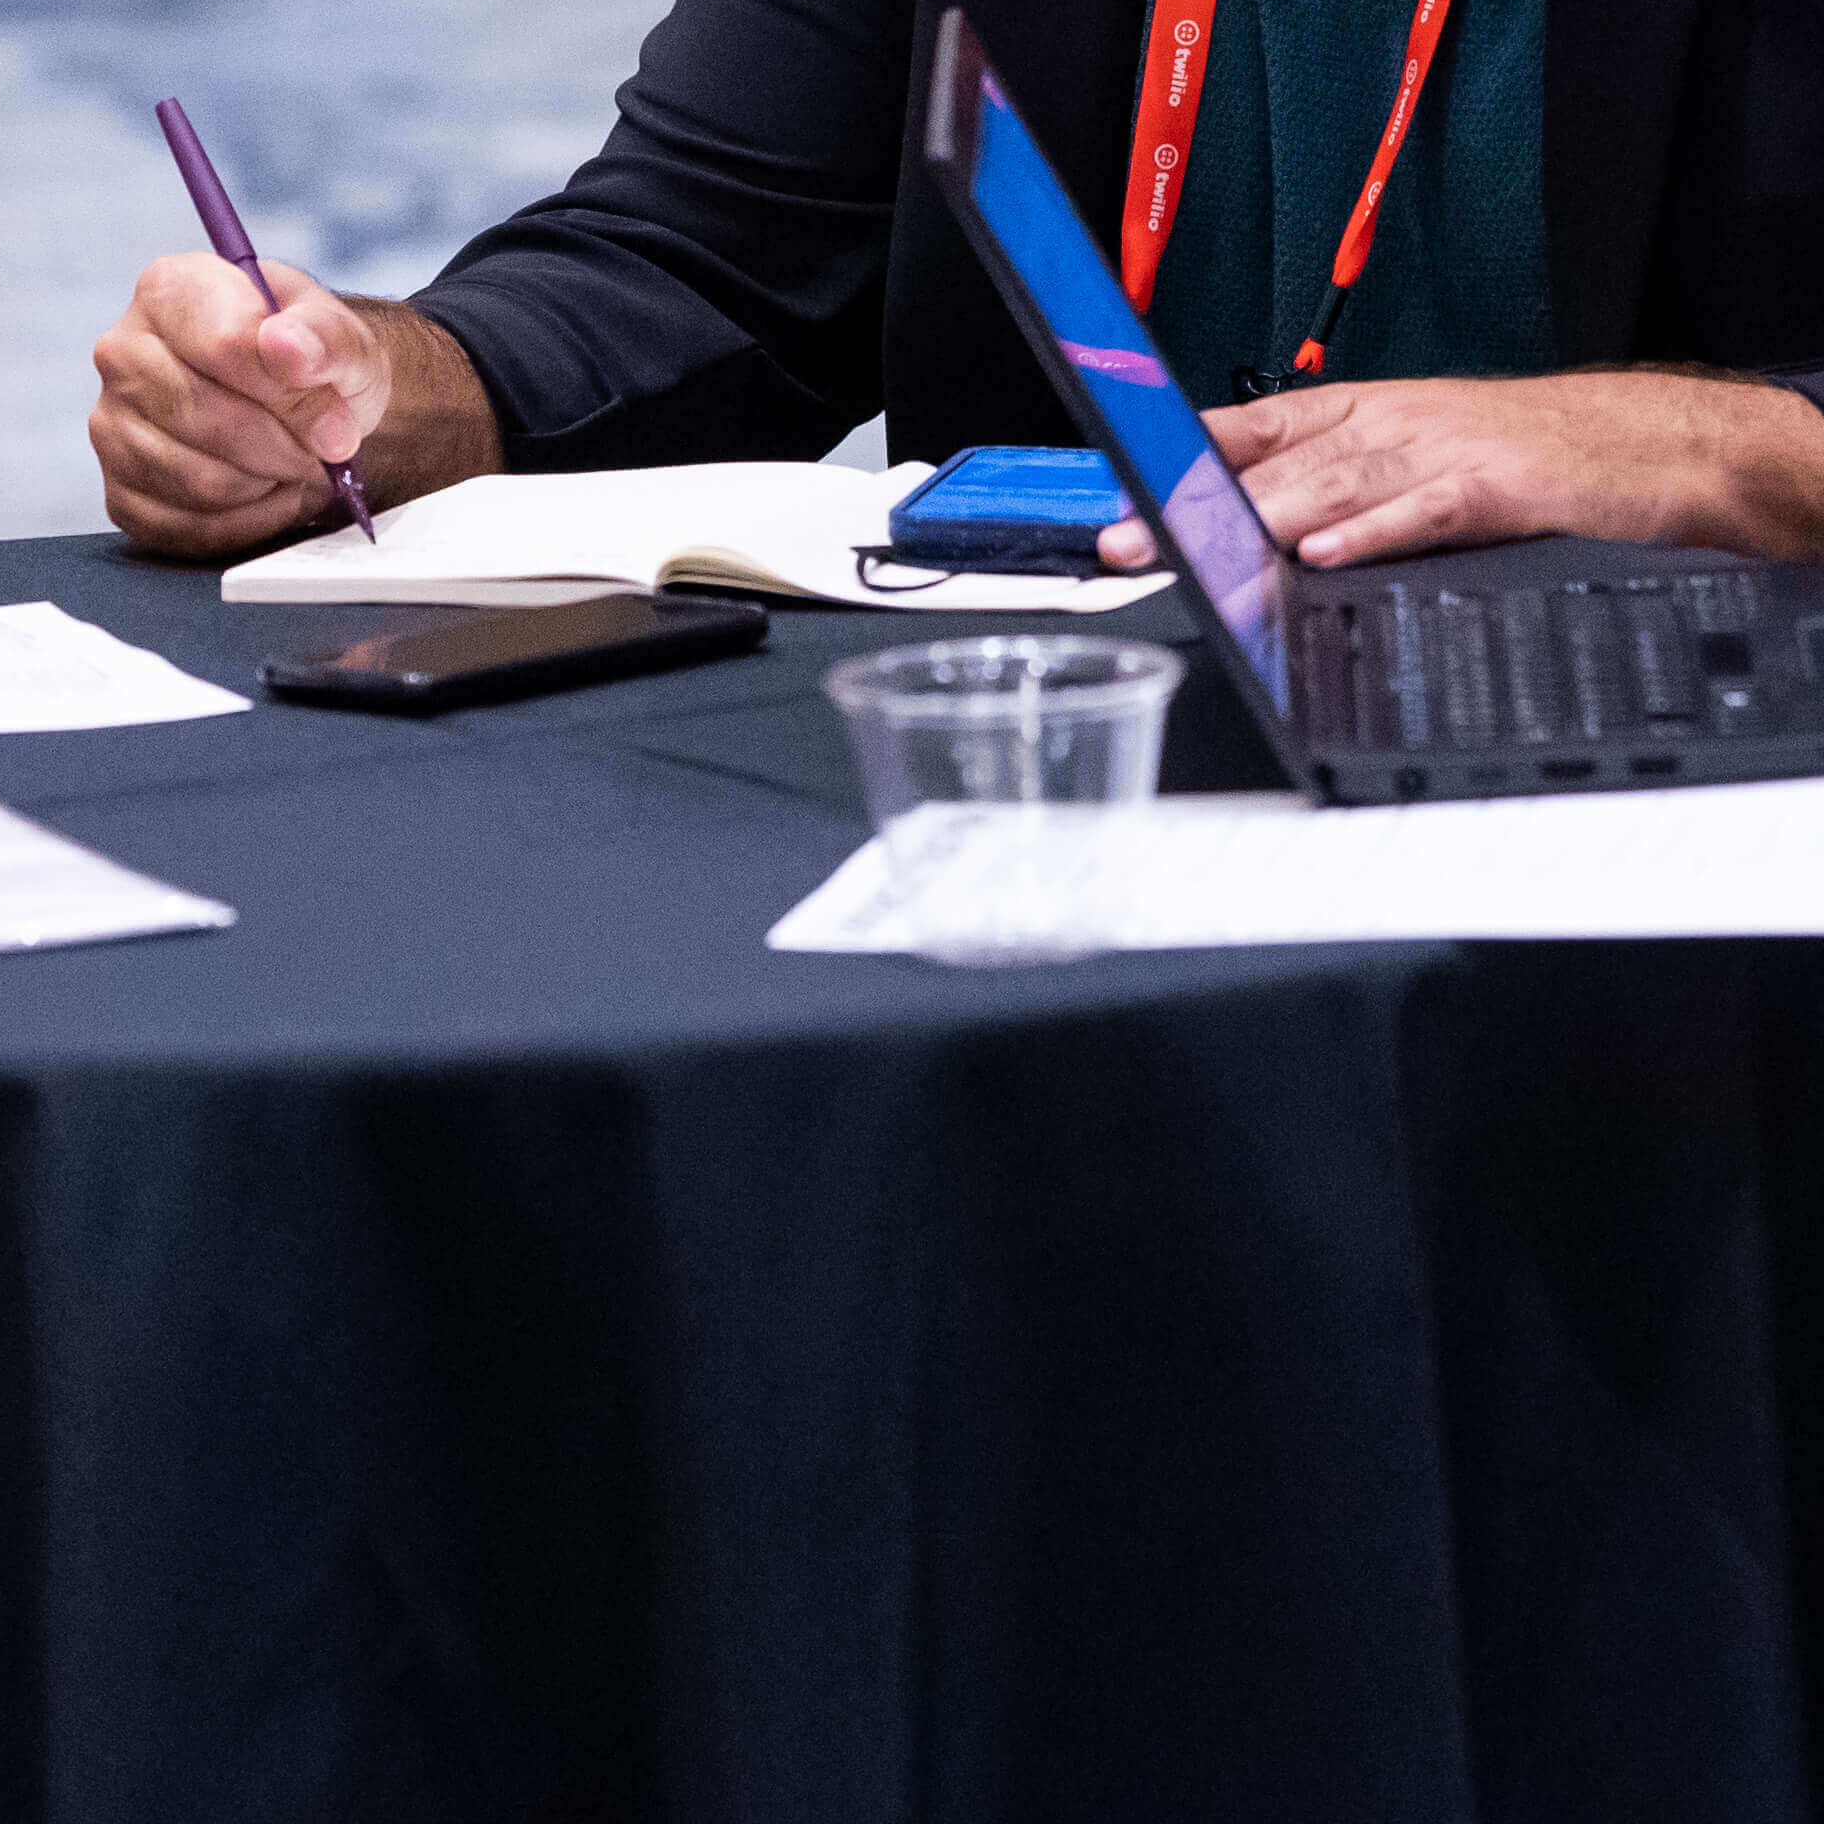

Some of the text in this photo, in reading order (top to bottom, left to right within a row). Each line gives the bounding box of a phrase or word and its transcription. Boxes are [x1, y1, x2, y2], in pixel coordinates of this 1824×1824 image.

[1168, 48, 1192, 107] twilio
[1388, 88, 1411, 146] twilio
[1148, 172, 1170, 231] twilio
